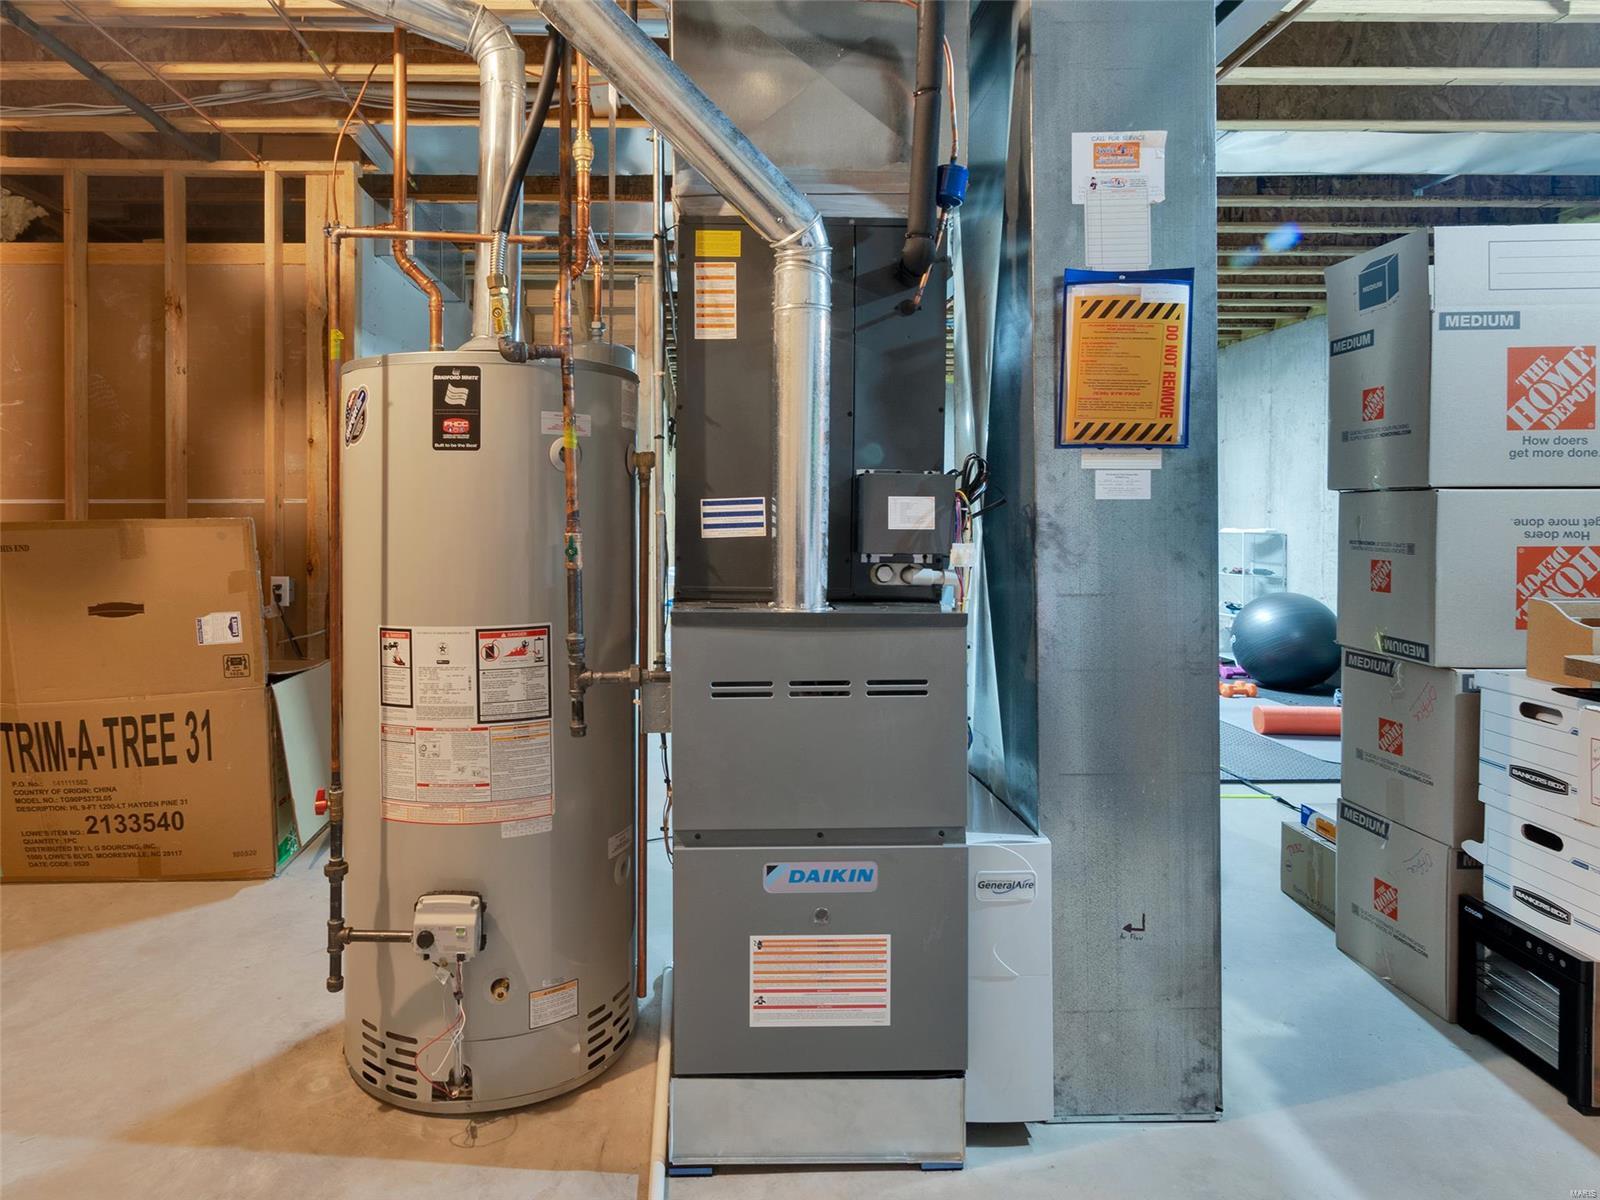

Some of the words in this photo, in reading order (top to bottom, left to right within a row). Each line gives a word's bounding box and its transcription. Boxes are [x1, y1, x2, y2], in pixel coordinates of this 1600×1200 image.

[1362, 280, 1384, 293] MEDIUM
[1445, 313, 1515, 328] MEDIUM
[1166, 325, 1179, 341] DO
[1333, 333, 1372, 354] MEDIUM
[1164, 345, 1178, 368] NOT
[1515, 355, 1553, 390] THE
[1160, 371, 1177, 419] REMOVE
[1507, 346, 1597, 430] HOME
[1362, 386, 1385, 421] HOME
[1541, 376, 1596, 431] DEPOT
[1522, 435, 1549, 446] How
[1553, 434, 1588, 446] doers
[1509, 448, 1529, 460] get
[1532, 449, 1564, 459] more
[1567, 447, 1600, 459] done.
[1548, 518, 1579, 527] more
[1524, 530, 1559, 540] doers
[1562, 530, 1590, 540] How
[14, 544, 30, 552] END
[1517, 546, 1572, 600] DEPOT
[1384, 639, 1426, 659] MEDIUM
[1348, 654, 1391, 674] MEDIUM
[0, 713, 178, 773] TRIM-A-TREE
[185, 709, 213, 763] 31
[1379, 723, 1404, 751] HOME
[1511, 768, 1547, 786] BANKERS
[1548, 778, 1566, 792] BOX
[13, 788, 49, 796] COUNTRY
[16, 804, 68, 813] DESCRIPTION:
[161, 799, 178, 807] PINE
[84, 810, 185, 835] 2133540
[1342, 806, 1387, 836] MEDIUM
[25, 845, 73, 853] DISTRIBUTED
[44, 852, 72, 860] LOWE'S
[788, 868, 874, 883] DAIKIN
[977, 879, 1034, 891] GeneralAire
[1374, 886, 1398, 911] HOME
[1515, 890, 1550, 911] BANKERS
[1551, 904, 1569, 921] BOX
